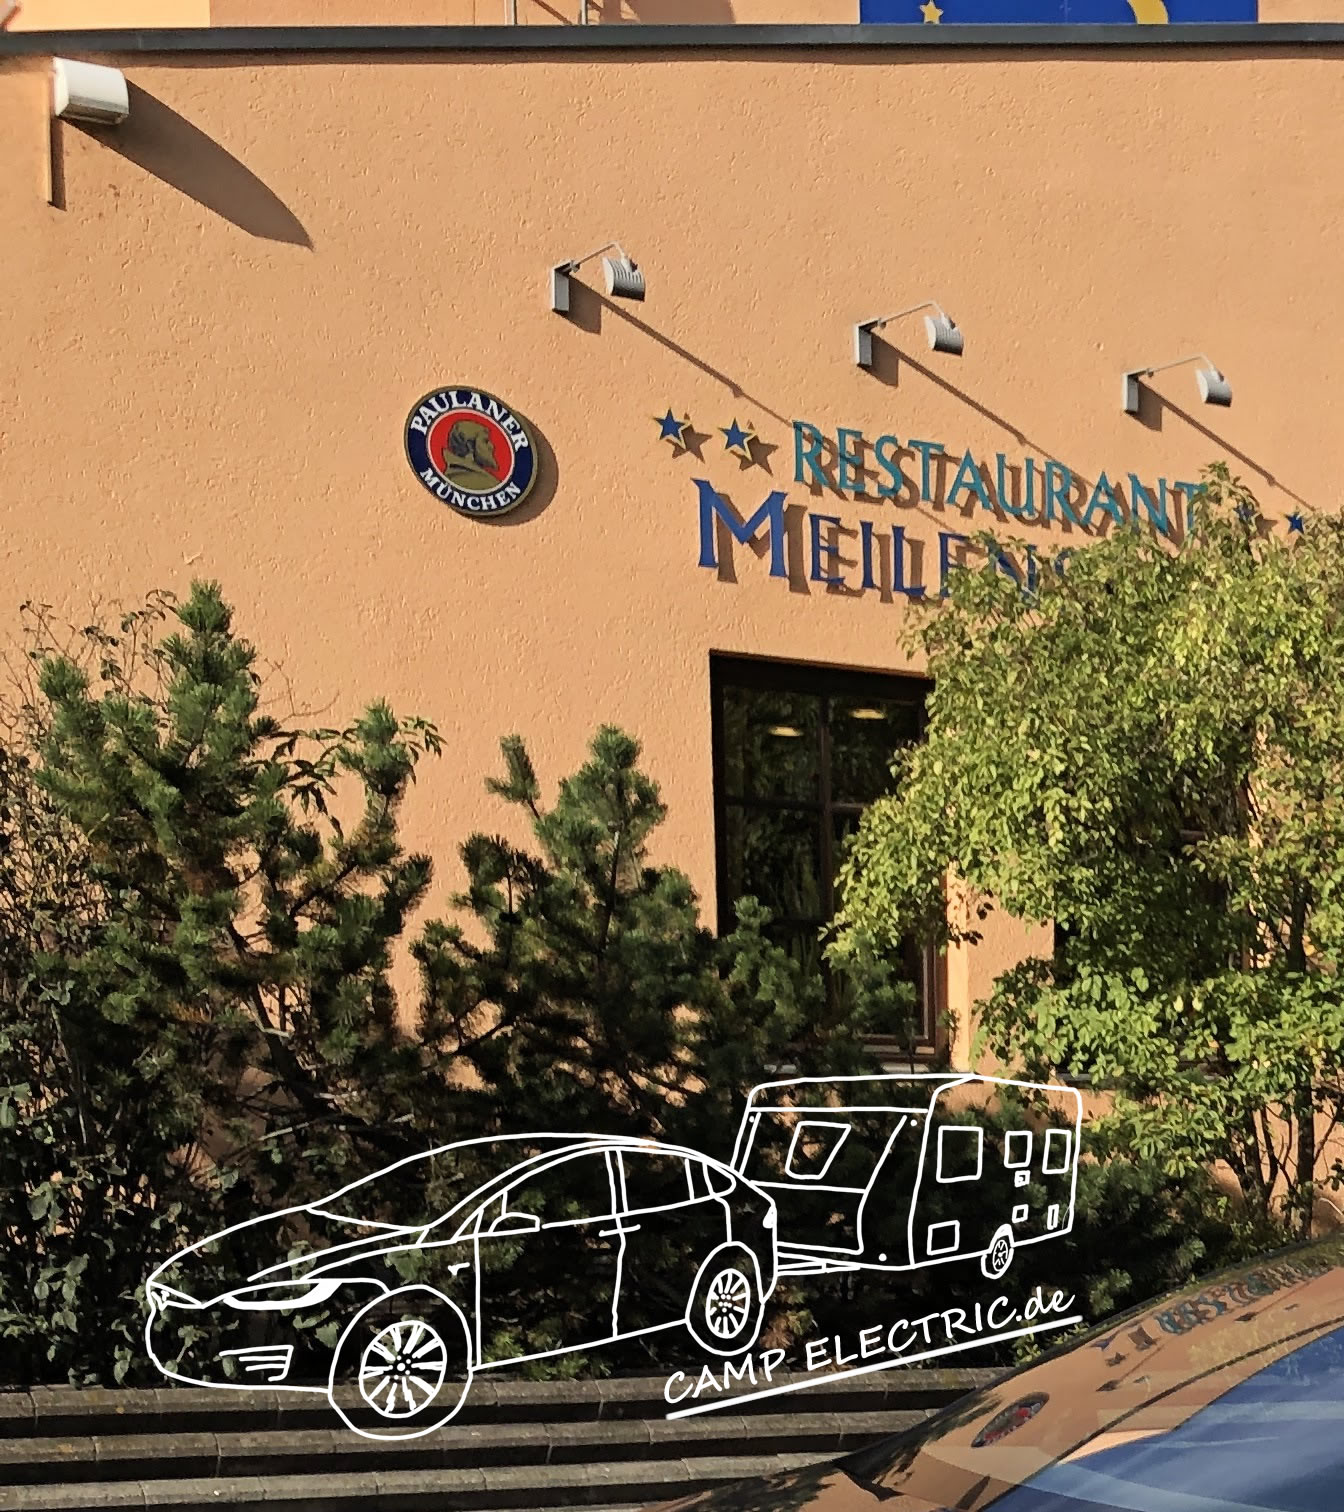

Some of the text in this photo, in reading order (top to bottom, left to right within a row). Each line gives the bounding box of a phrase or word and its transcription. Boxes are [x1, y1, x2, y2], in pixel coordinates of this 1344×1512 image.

[410, 389, 529, 452] PAULANER
[419, 467, 522, 511] MÜNCHEN
[792, 419, 1208, 540] RESTAURANT
